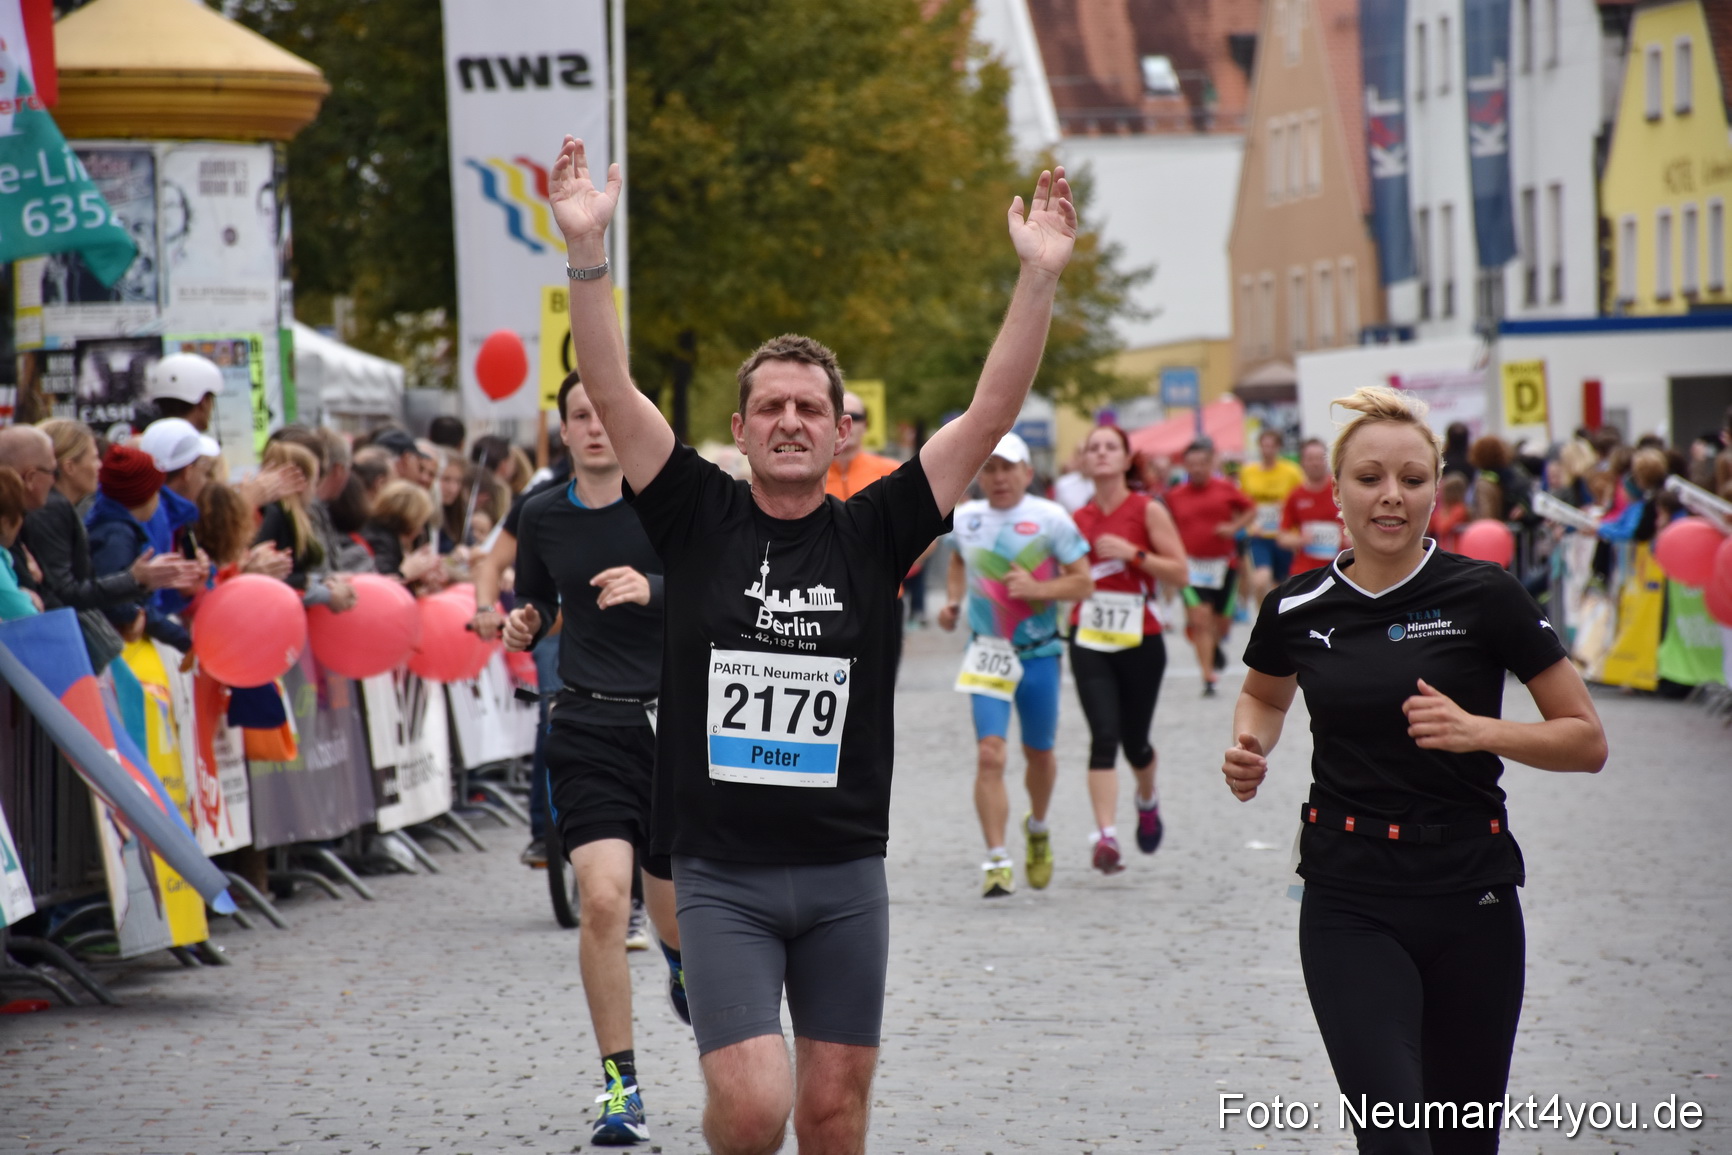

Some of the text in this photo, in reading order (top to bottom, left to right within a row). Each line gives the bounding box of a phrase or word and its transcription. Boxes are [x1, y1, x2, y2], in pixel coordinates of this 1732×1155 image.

[1514, 379, 1539, 412] D
[755, 605, 822, 636] Berlin
[1092, 606, 1131, 630] 317
[1407, 609, 1441, 620] TEAM
[1407, 619, 1452, 632] Himmler
[755, 632, 795, 649] 42,195
[798, 633, 817, 651] km
[1406, 629, 1467, 639] MASCHINENBAU
[713, 662, 829, 683] PARTL Neumarkt
[975, 652, 1012, 676] 305
[721, 682, 838, 737] 2179
[712, 724, 718, 735] C
[751, 745, 800, 768] Peter
